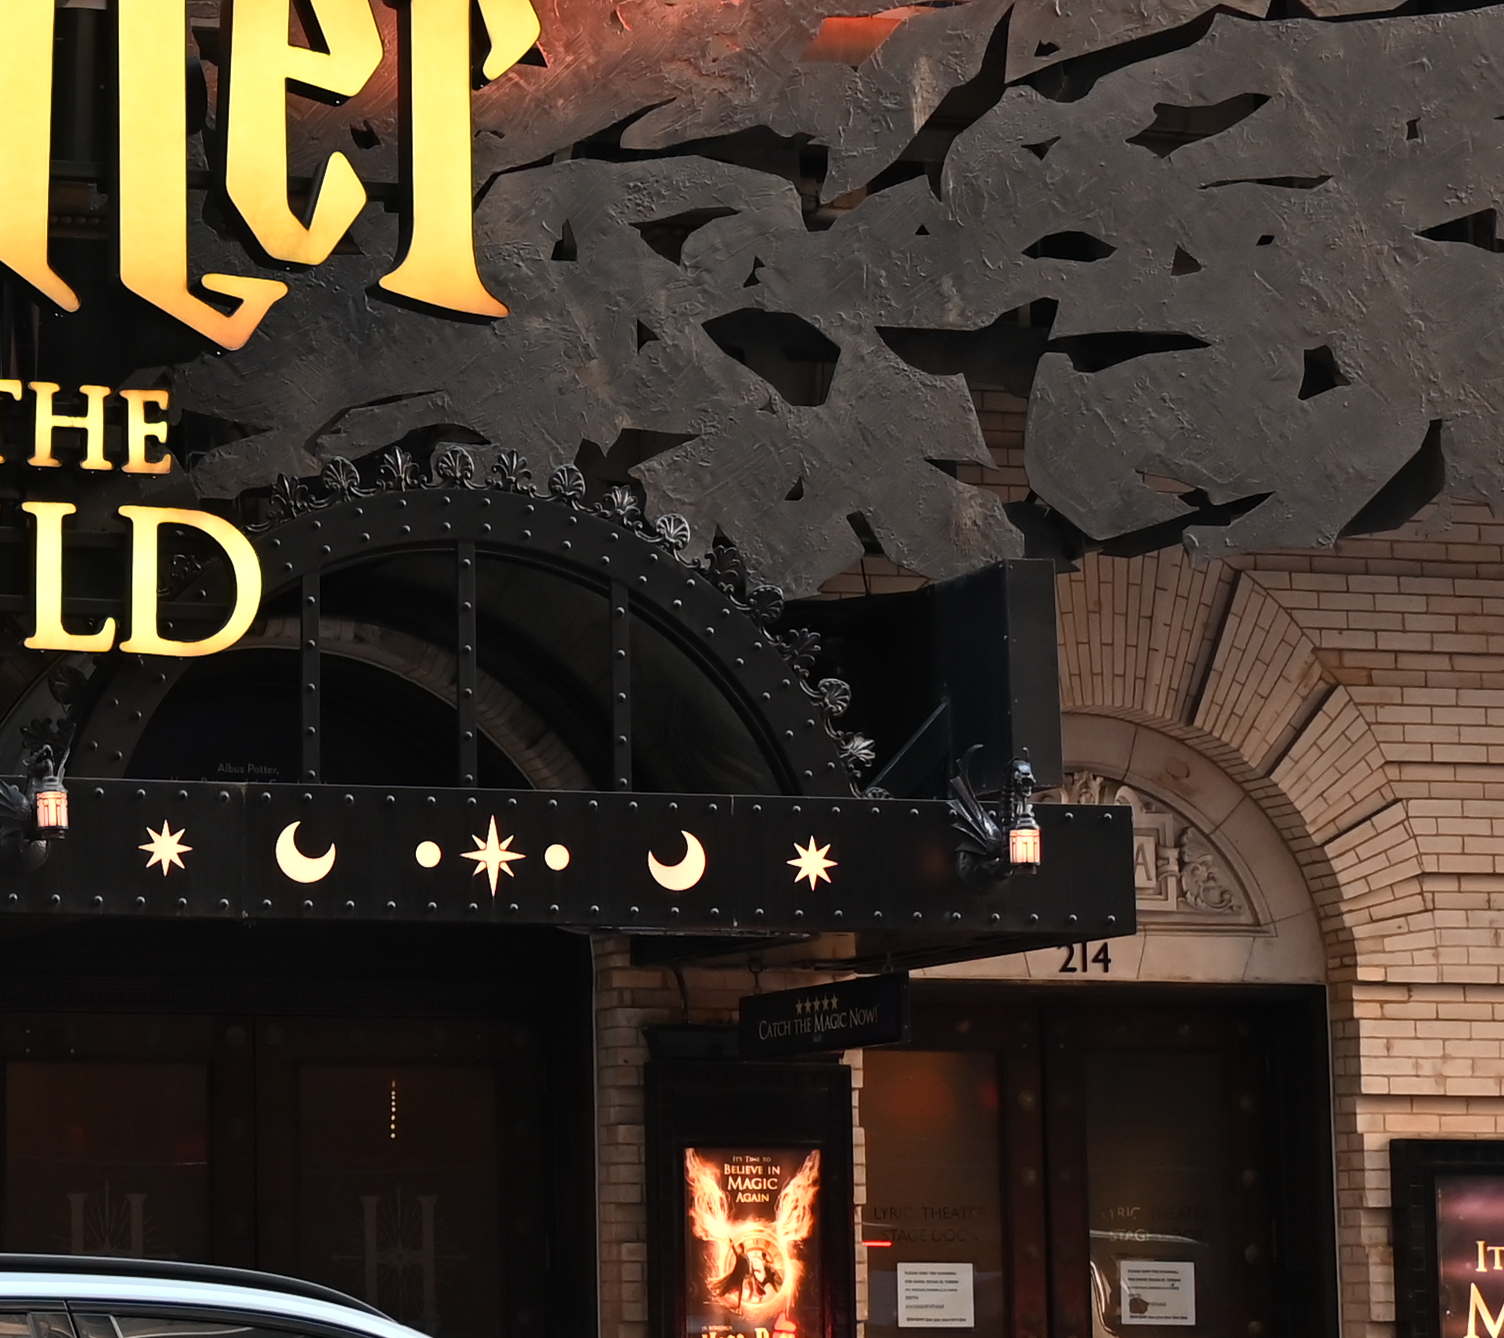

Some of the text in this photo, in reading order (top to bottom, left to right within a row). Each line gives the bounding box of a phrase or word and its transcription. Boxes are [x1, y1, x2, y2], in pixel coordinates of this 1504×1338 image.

[1058, 941, 1112, 973] 214
[758, 1019, 791, 1041] CATCH
[793, 1017, 812, 1035] THE
[813, 1012, 847, 1034] MAGIC
[723, 1163, 781, 1175] BELIEVE IN
[727, 1175, 779, 1190] MAGIC
[735, 1191, 770, 1203] AGAIN
[931, 1229, 979, 1242] DOO
